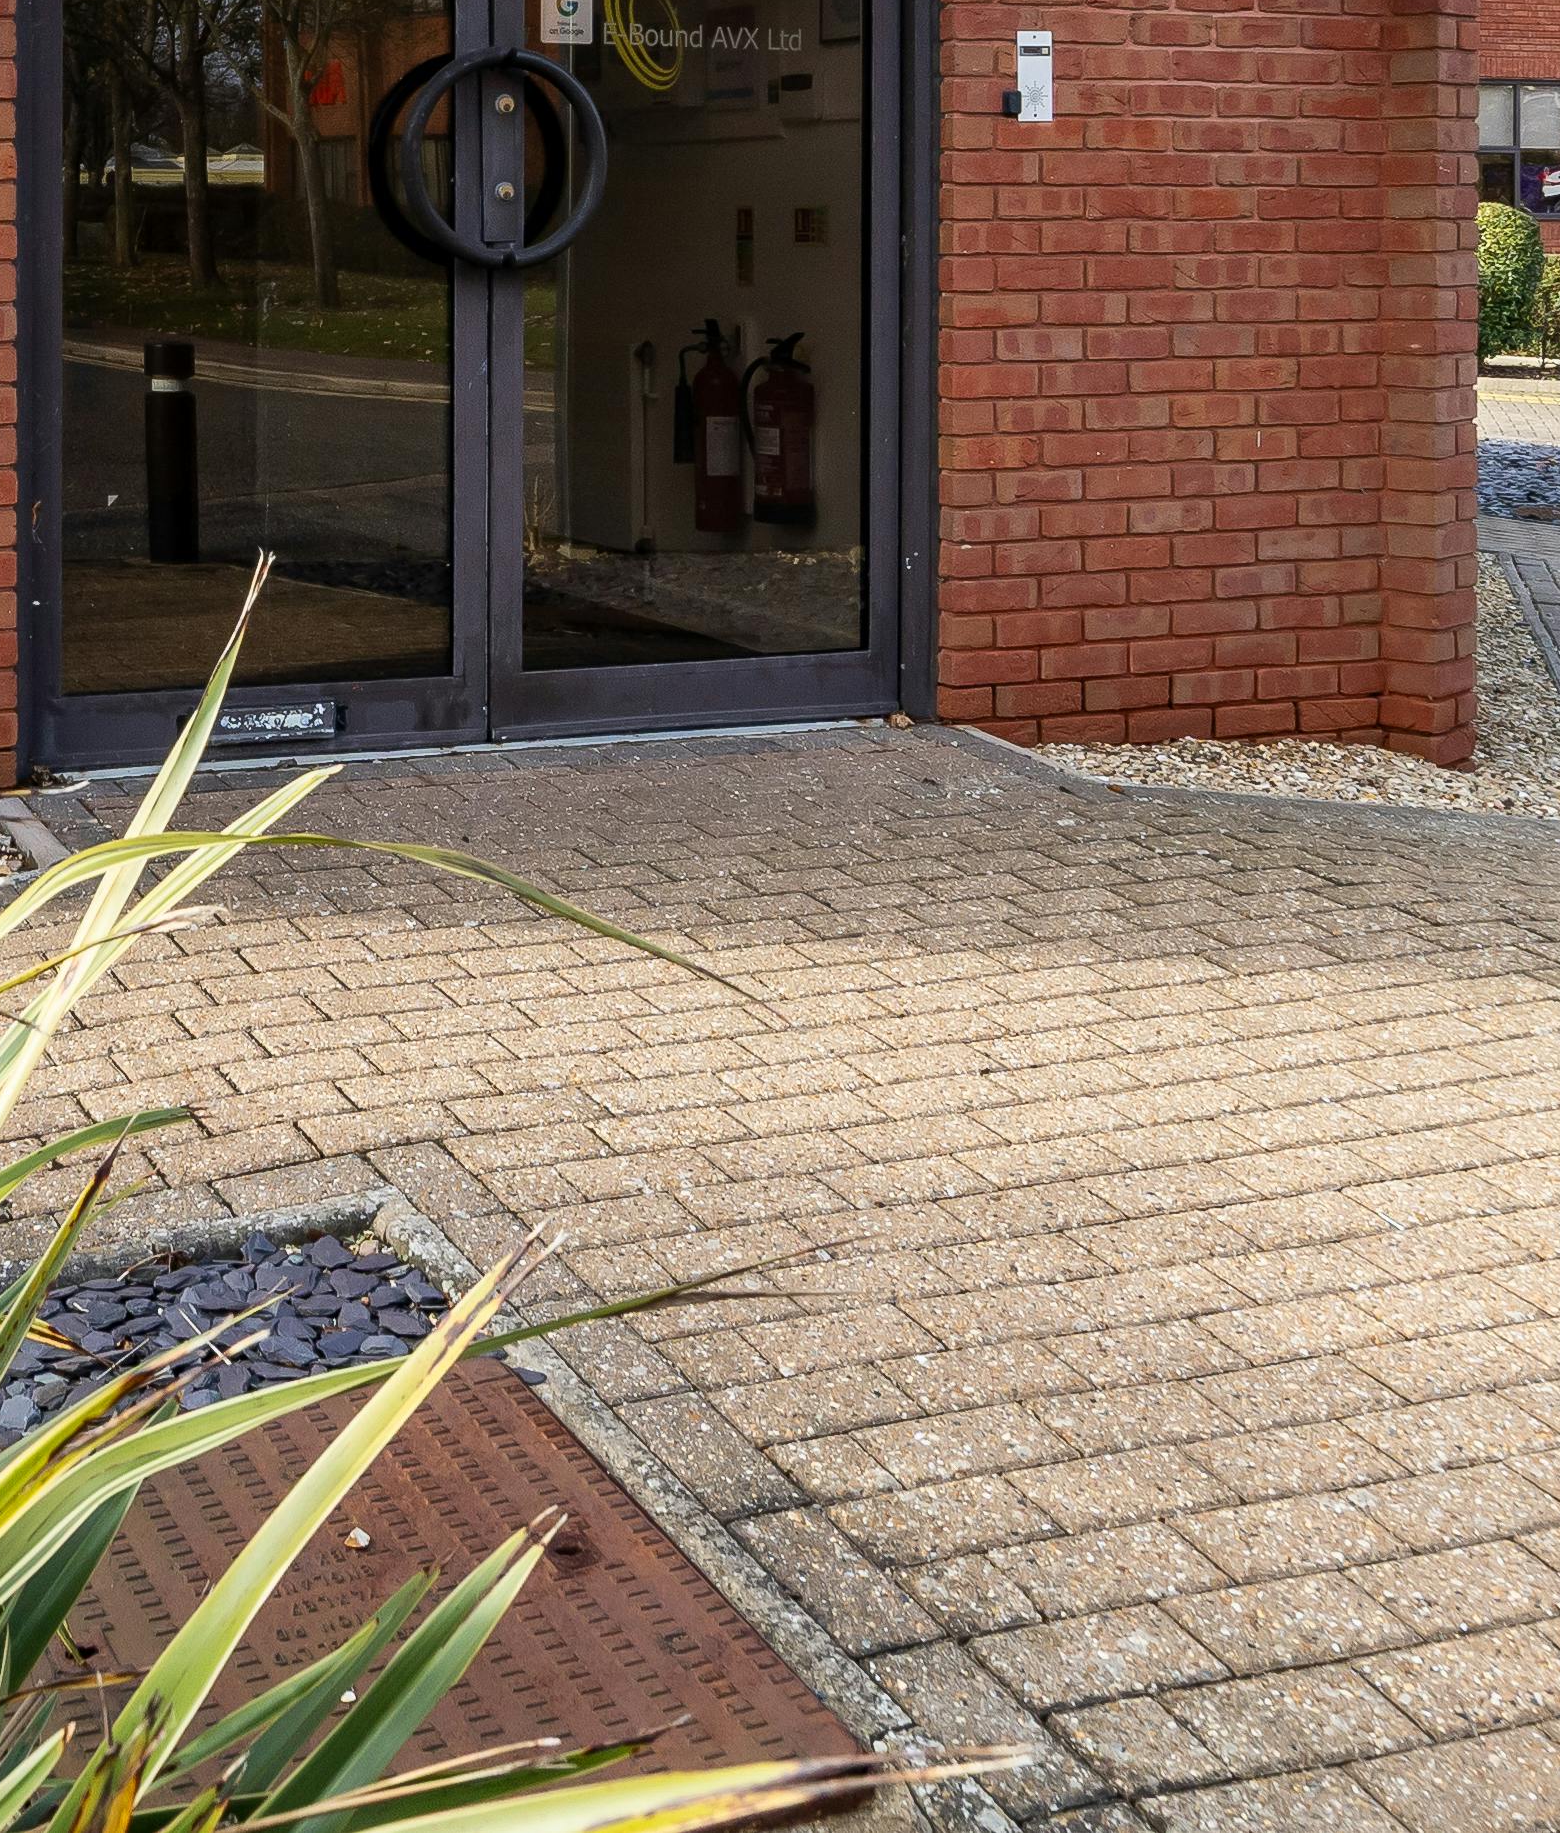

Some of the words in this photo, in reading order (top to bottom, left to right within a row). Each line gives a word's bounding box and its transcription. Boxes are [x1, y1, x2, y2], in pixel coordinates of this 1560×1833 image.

[603, 22, 703, 48] E-Bound
[711, 26, 759, 50] AVX
[768, 28, 802, 51] Ltd
